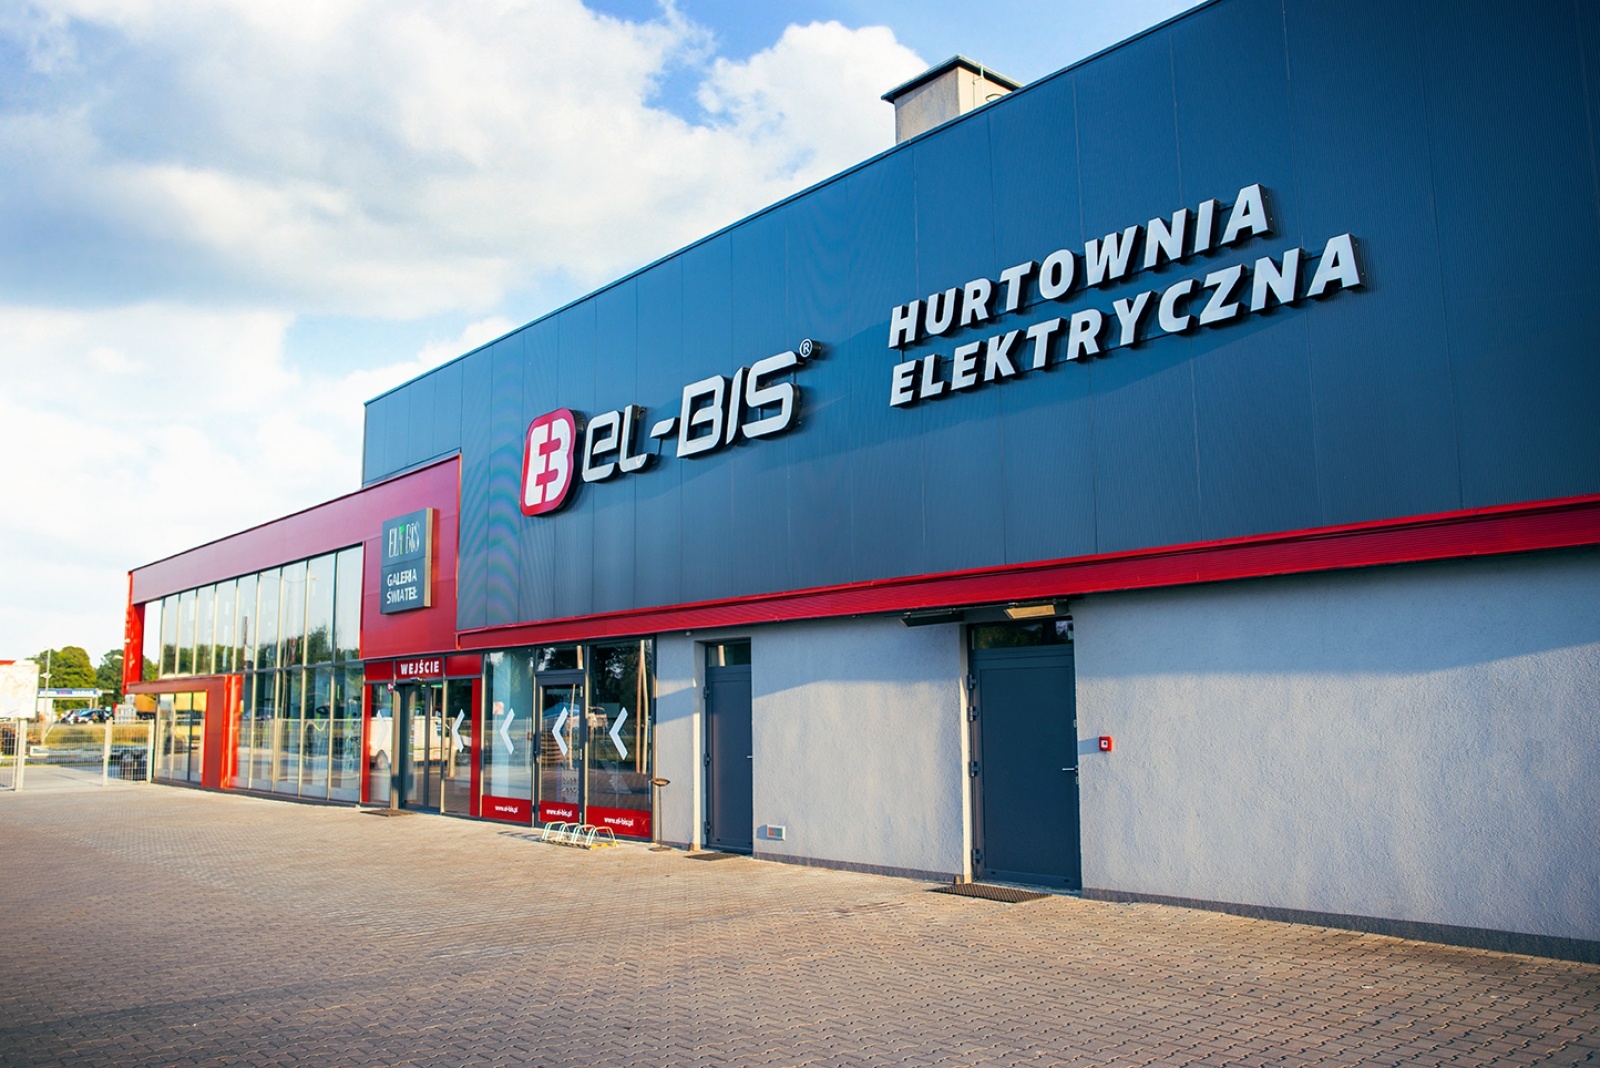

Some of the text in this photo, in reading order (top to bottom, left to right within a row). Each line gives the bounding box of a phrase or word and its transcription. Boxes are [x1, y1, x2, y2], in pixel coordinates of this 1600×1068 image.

[888, 183, 1272, 348] HURTOWNIA
[889, 233, 1363, 406] ELEKTRYCZNA
[386, 568, 418, 587] GALERIA
[400, 659, 440, 675] WEJŚCIE
